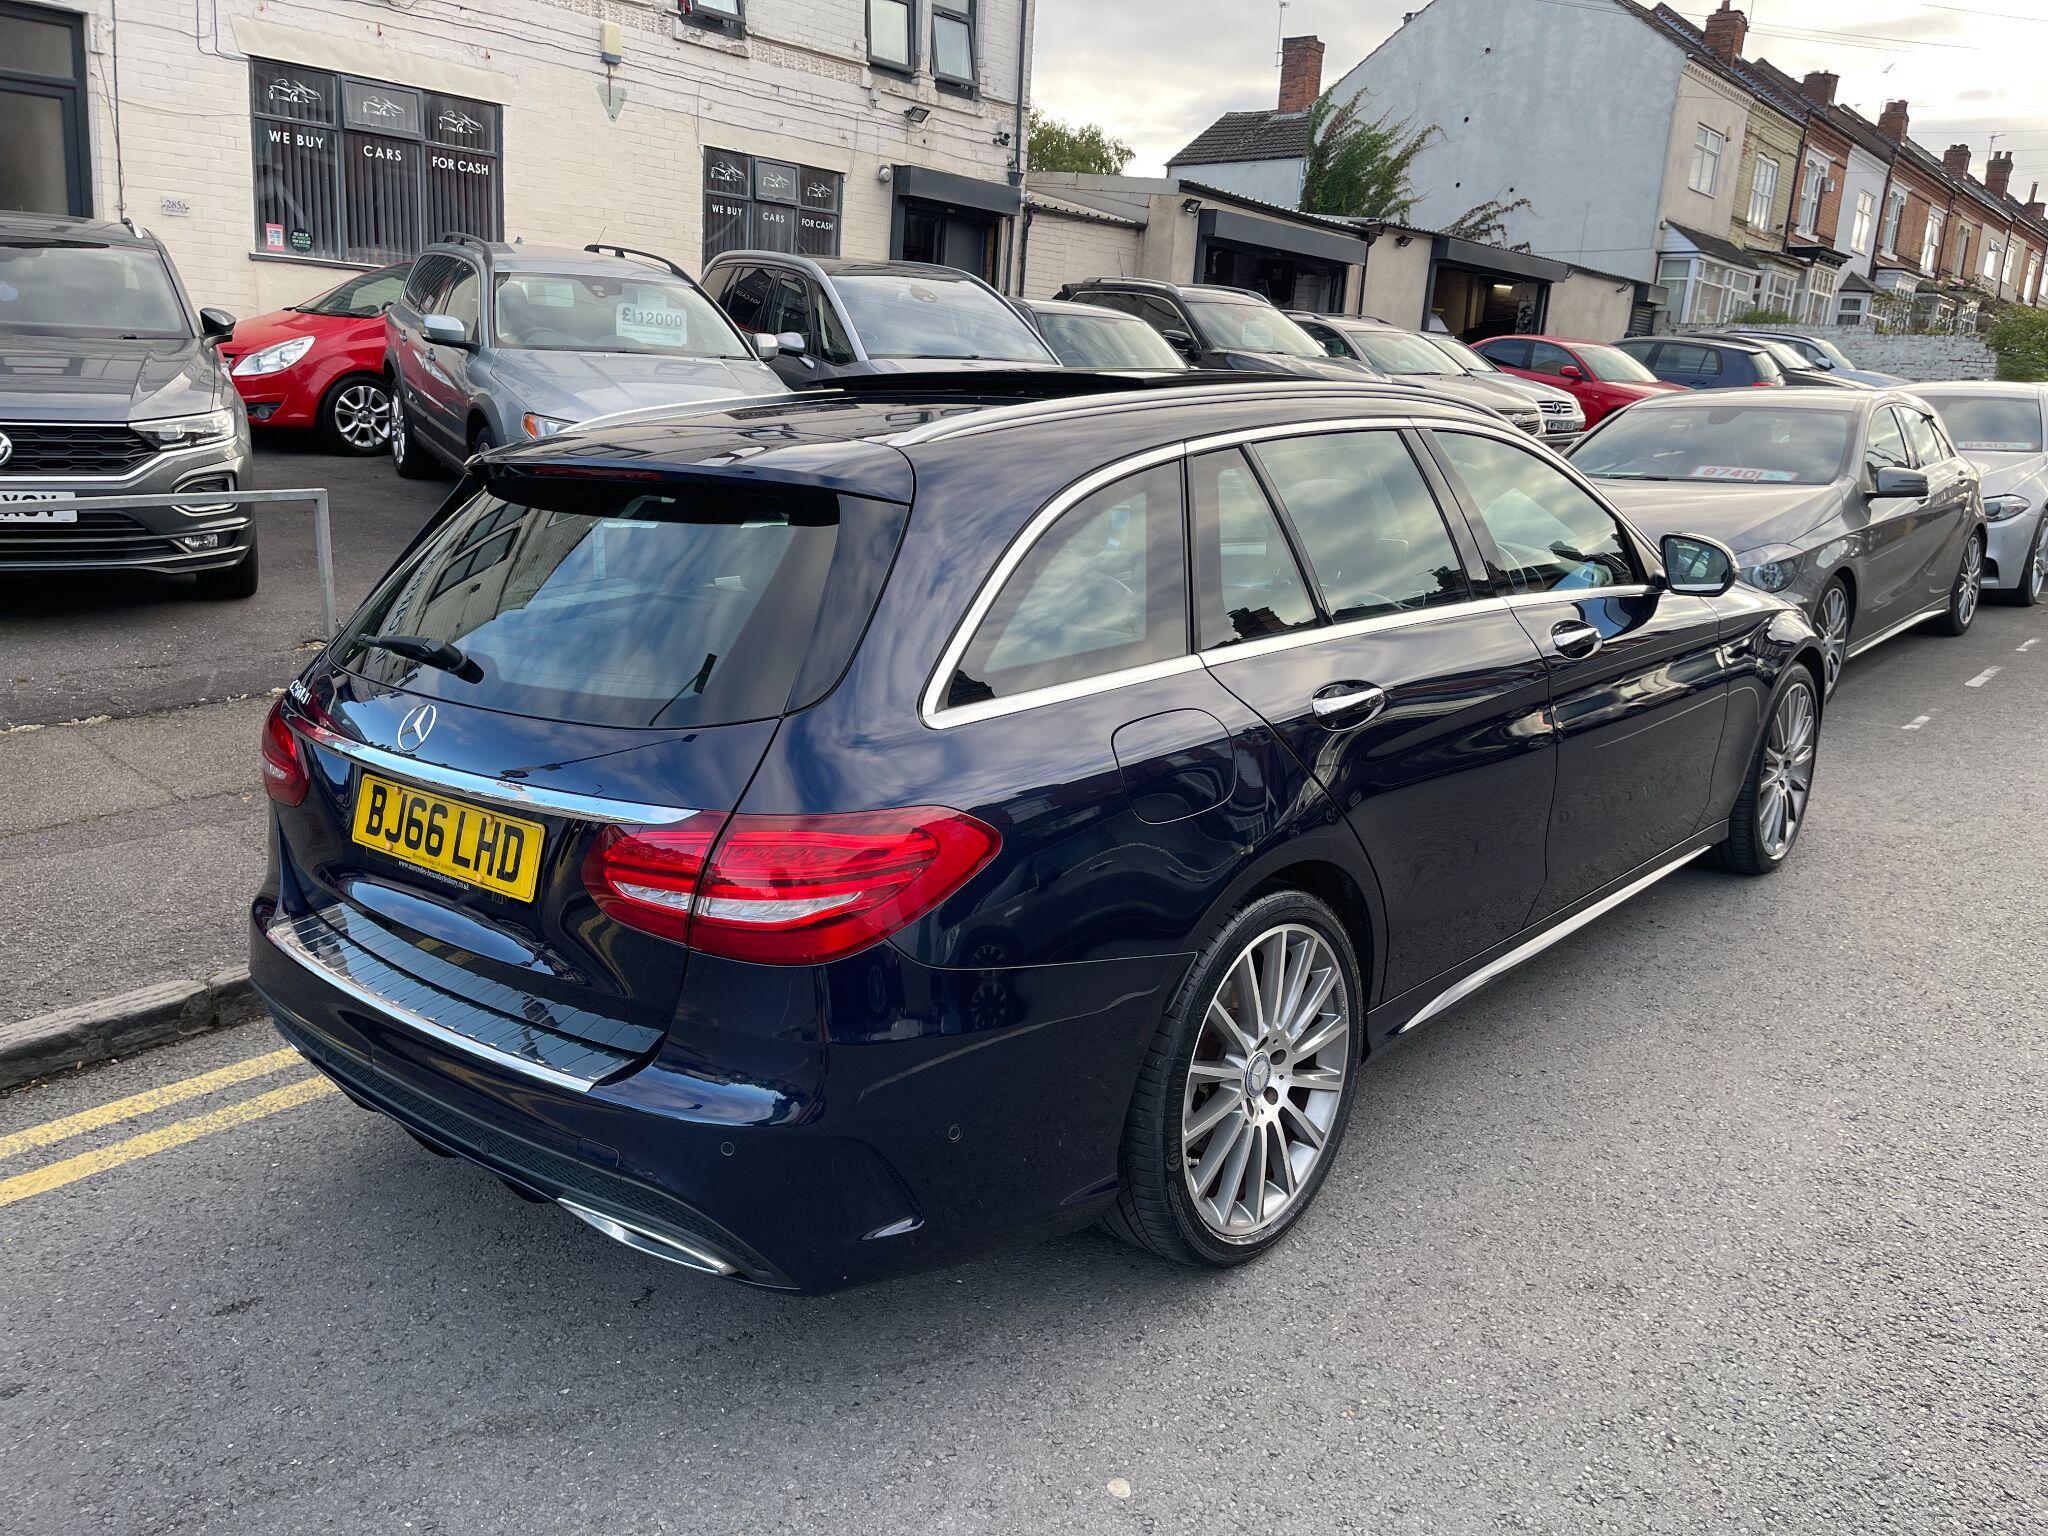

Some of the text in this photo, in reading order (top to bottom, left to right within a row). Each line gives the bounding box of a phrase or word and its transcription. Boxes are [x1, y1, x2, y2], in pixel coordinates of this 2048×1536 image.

[268, 129, 489, 176] WE BUY CARS FOR CASH
[711, 203, 834, 231] WE BUY CARS FOR CASH
[366, 784, 525, 883] BJ66 LHD
